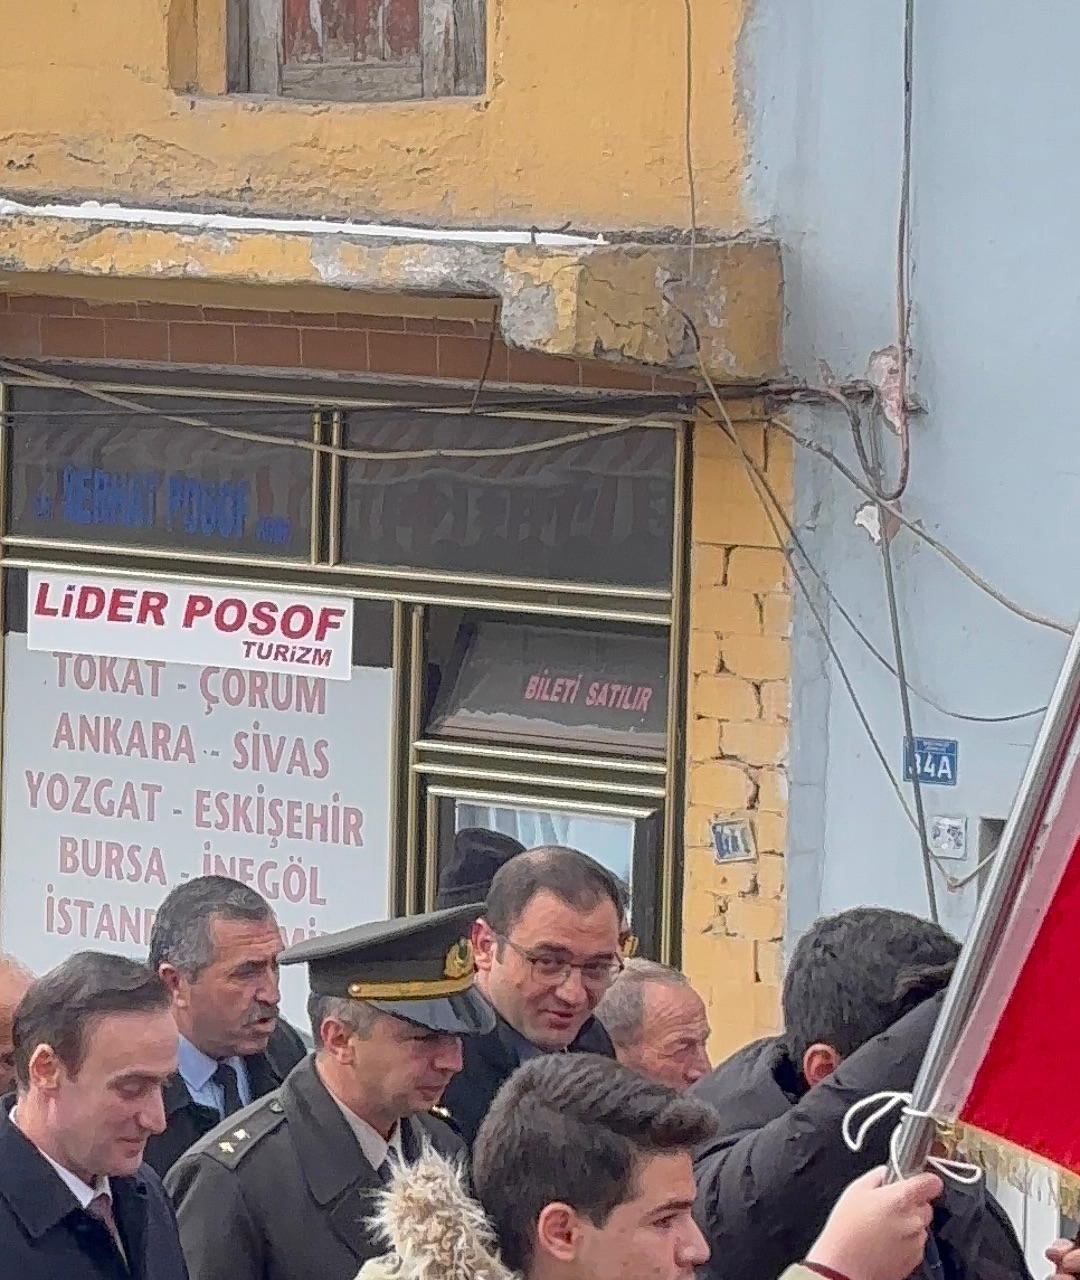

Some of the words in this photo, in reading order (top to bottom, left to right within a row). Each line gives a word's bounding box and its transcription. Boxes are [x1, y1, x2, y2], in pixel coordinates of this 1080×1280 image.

[182, 593, 346, 642] POSOF
[52, 651, 166, 697] TOKAT
[199, 666, 326, 715] ÇORUM
[524, 669, 583, 704] BİLETİ
[586, 682, 652, 712] SATILIR
[52, 712, 196, 764] ANKARA
[233, 720, 330, 779] SİVAS
[24, 769, 163, 822] YOZGAT
[195, 783, 364, 848] ESKİŞEHİR
[59, 836, 167, 886] BURSA
[45, 883, 156, 945] İSTAN
